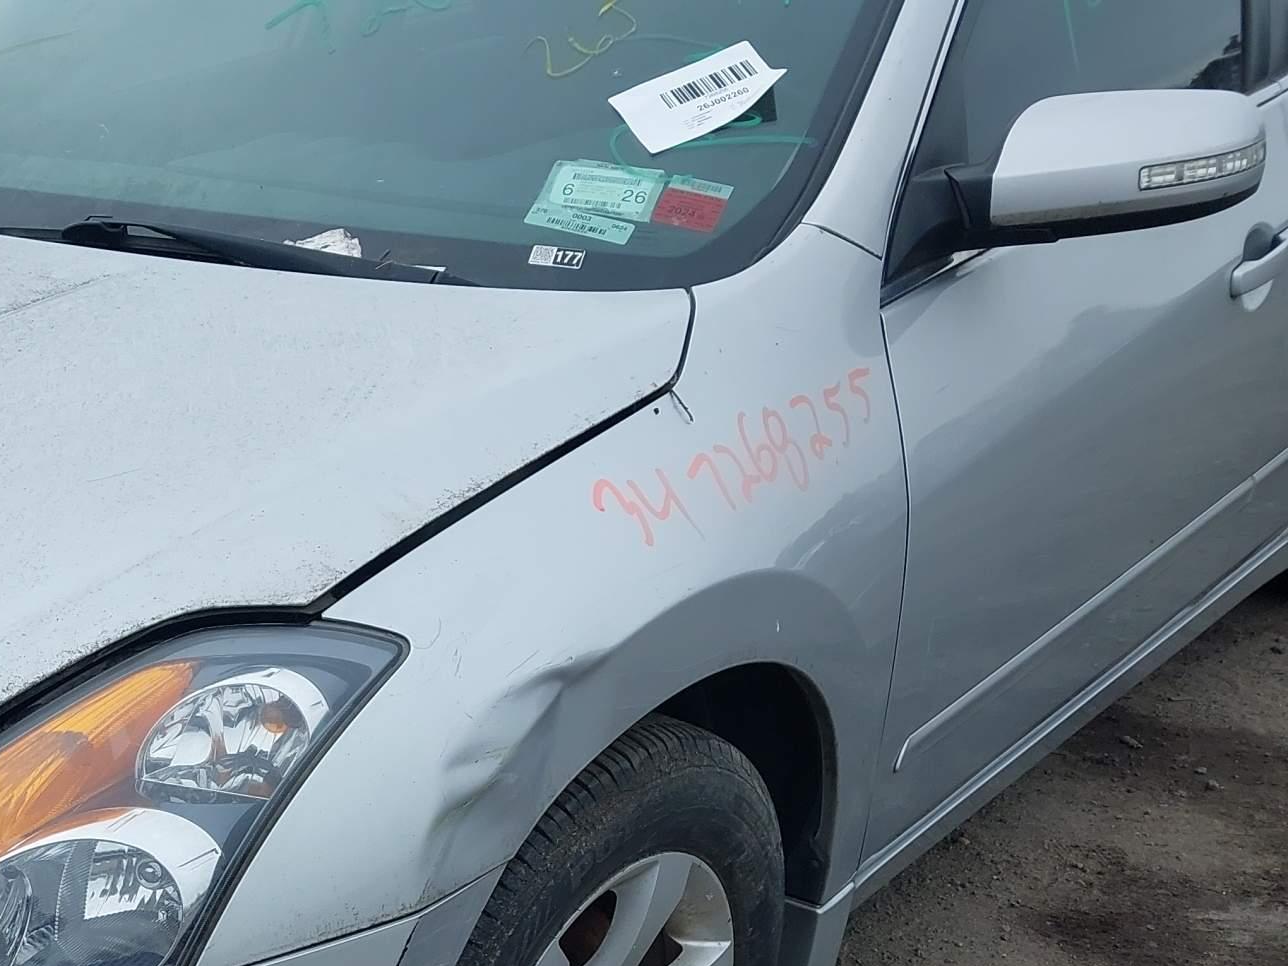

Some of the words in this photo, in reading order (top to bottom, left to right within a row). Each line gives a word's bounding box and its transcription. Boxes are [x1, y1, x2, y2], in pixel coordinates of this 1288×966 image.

[562, 183, 575, 196] 6
[621, 189, 648, 205] 26
[556, 251, 582, 265] 177
